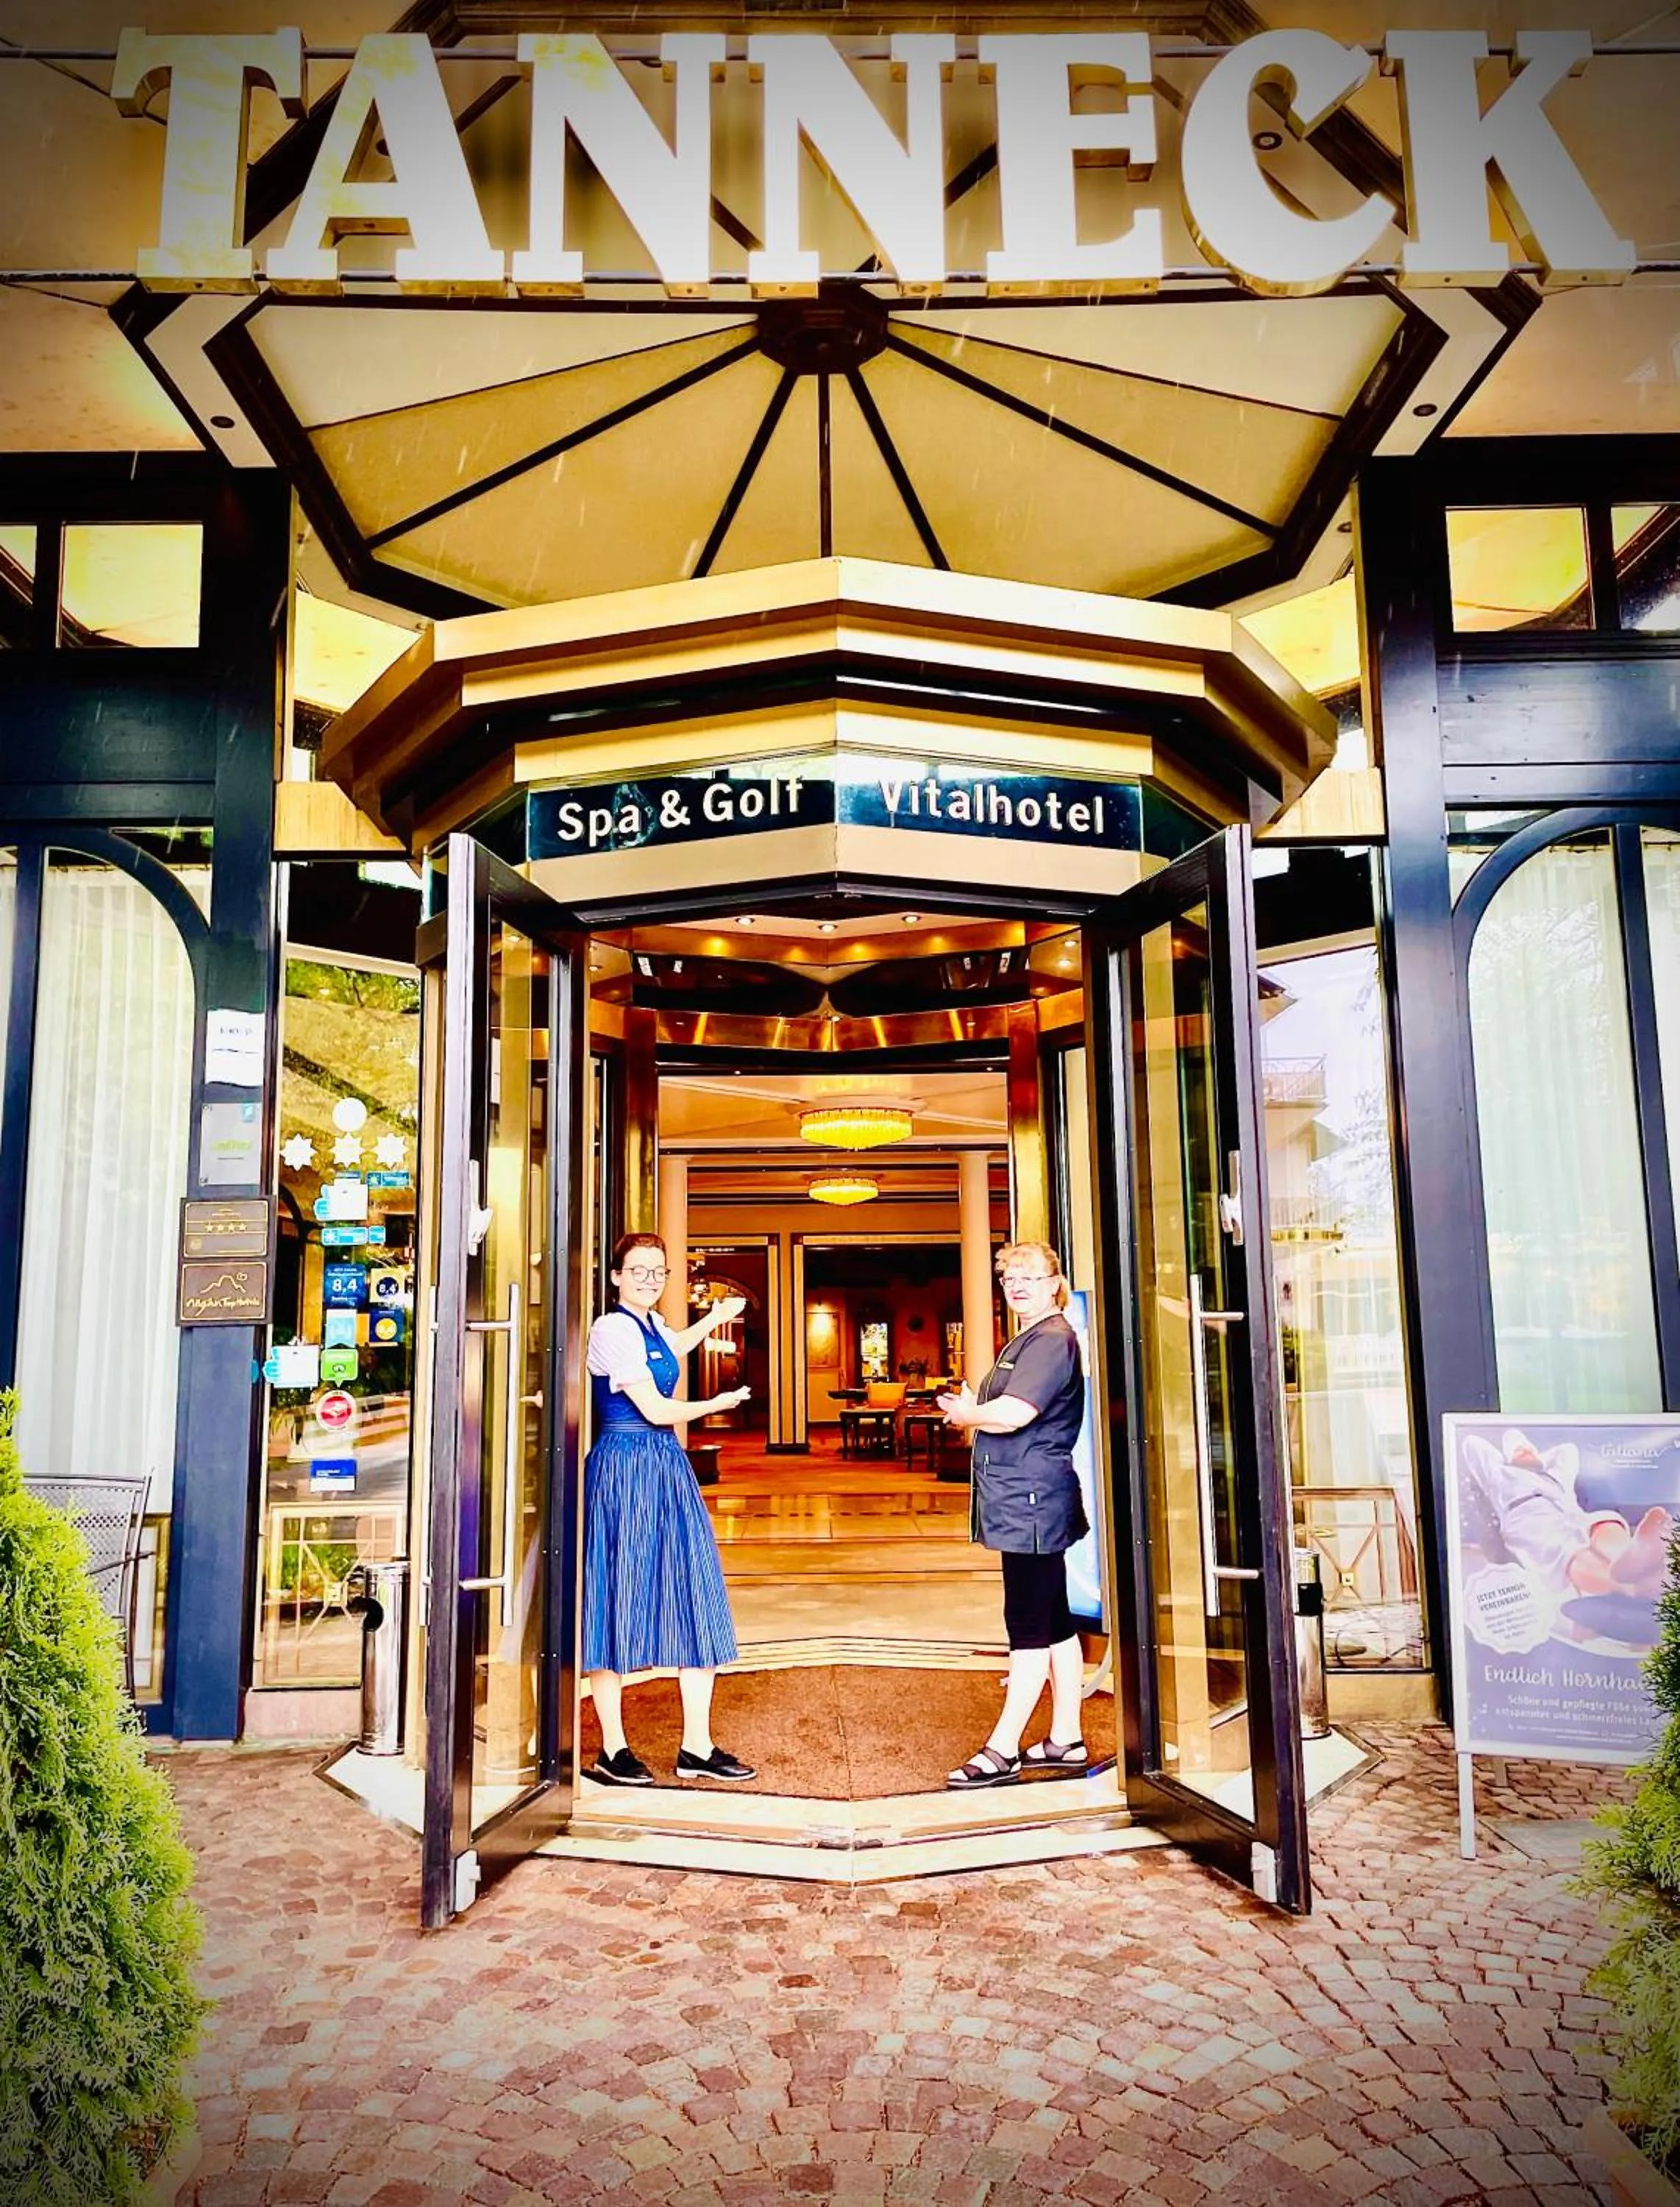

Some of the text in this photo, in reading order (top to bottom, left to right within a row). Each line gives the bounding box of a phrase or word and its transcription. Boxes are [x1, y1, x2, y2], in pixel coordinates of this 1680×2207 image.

[111, 27, 1637, 297] TANNECK
[558, 775, 804, 847] Spa & Golf
[878, 779, 1104, 834] Vitalhotel
[332, 1278, 357, 1295] 8,4
[1484, 1665, 1554, 1687] Endlich
